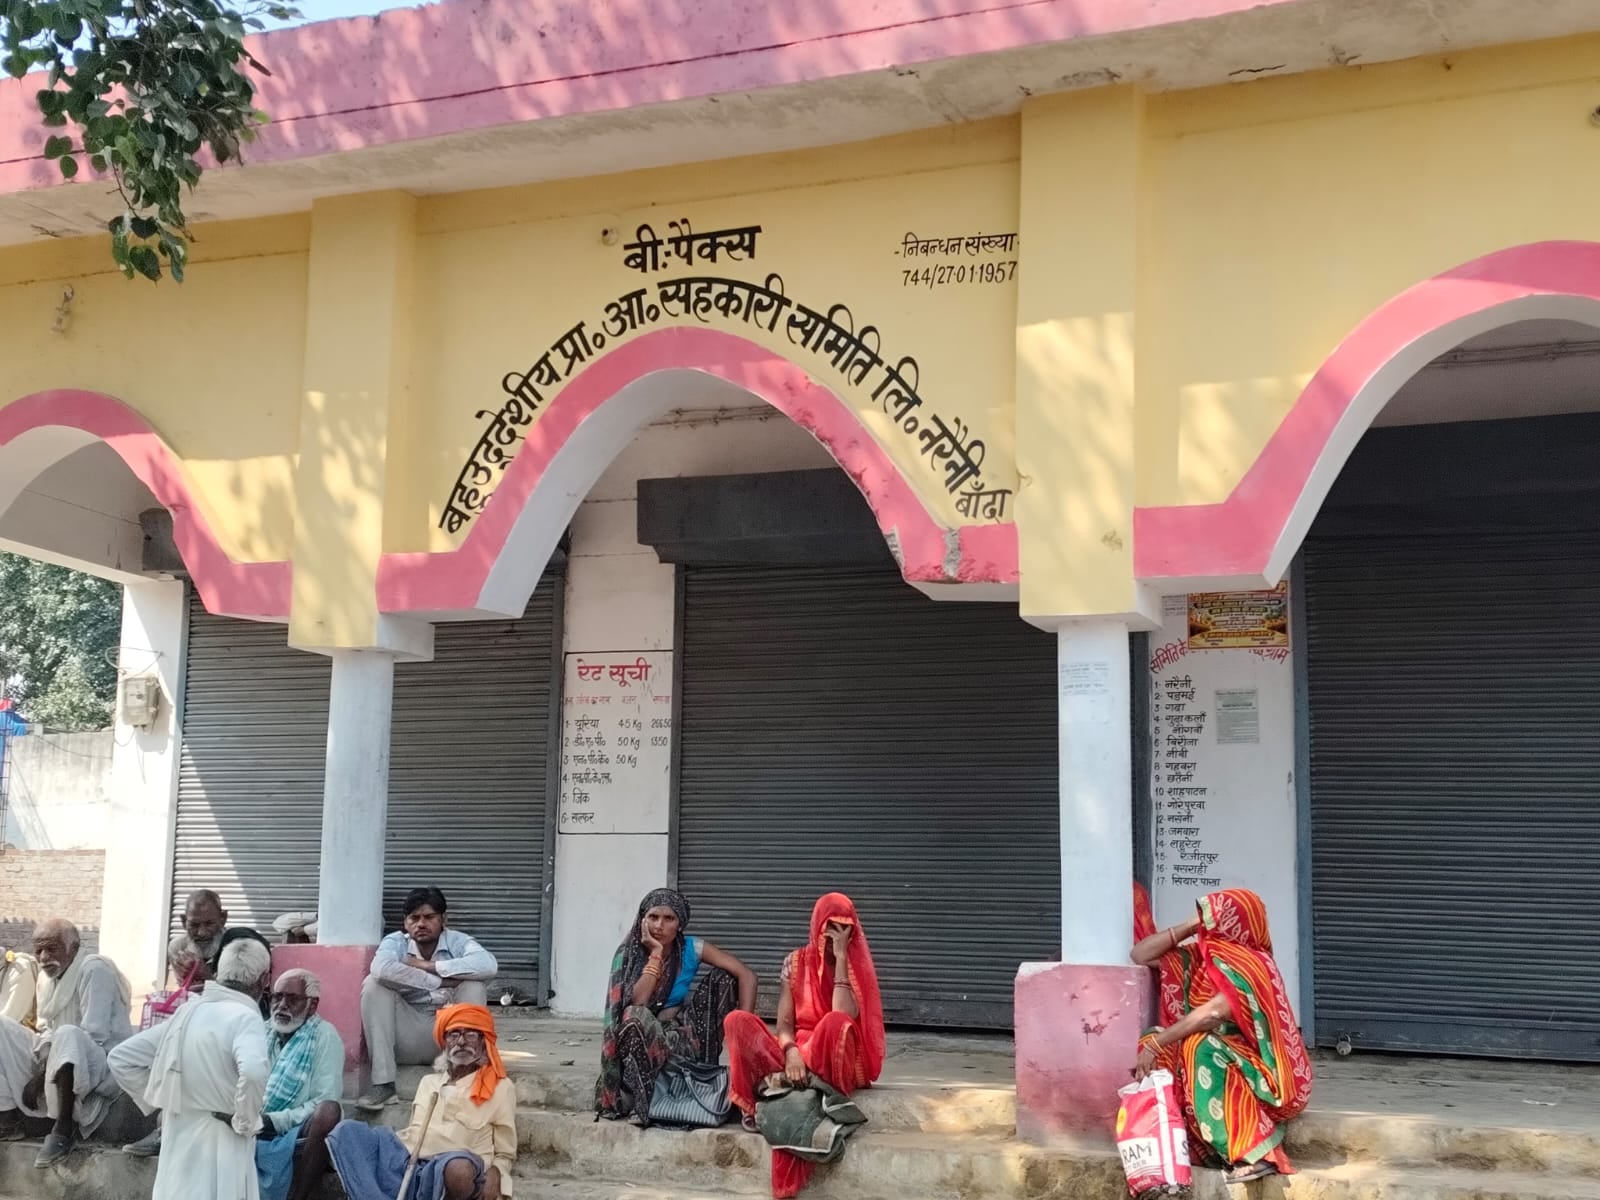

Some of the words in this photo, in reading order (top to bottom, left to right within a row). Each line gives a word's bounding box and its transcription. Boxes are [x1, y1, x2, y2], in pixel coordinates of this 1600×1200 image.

[901, 232, 964, 258] निबन्धन
[965, 232, 1017, 256] संख्या
[787, 303, 883, 386] समिति
[1150, 643, 1180, 674] समिति
[577, 658, 605, 681] रेट
[609, 657, 652, 687] सूची
[1165, 675, 1192, 690] नरैनी
[574, 714, 600, 732] यूरिया
[618, 719, 631, 728] 45
[632, 719, 642, 731] Kg
[617, 737, 629, 746] 50
[631, 737, 640, 750] Kg
[616, 754, 626, 764] 50
[628, 754, 637, 768] Kg
